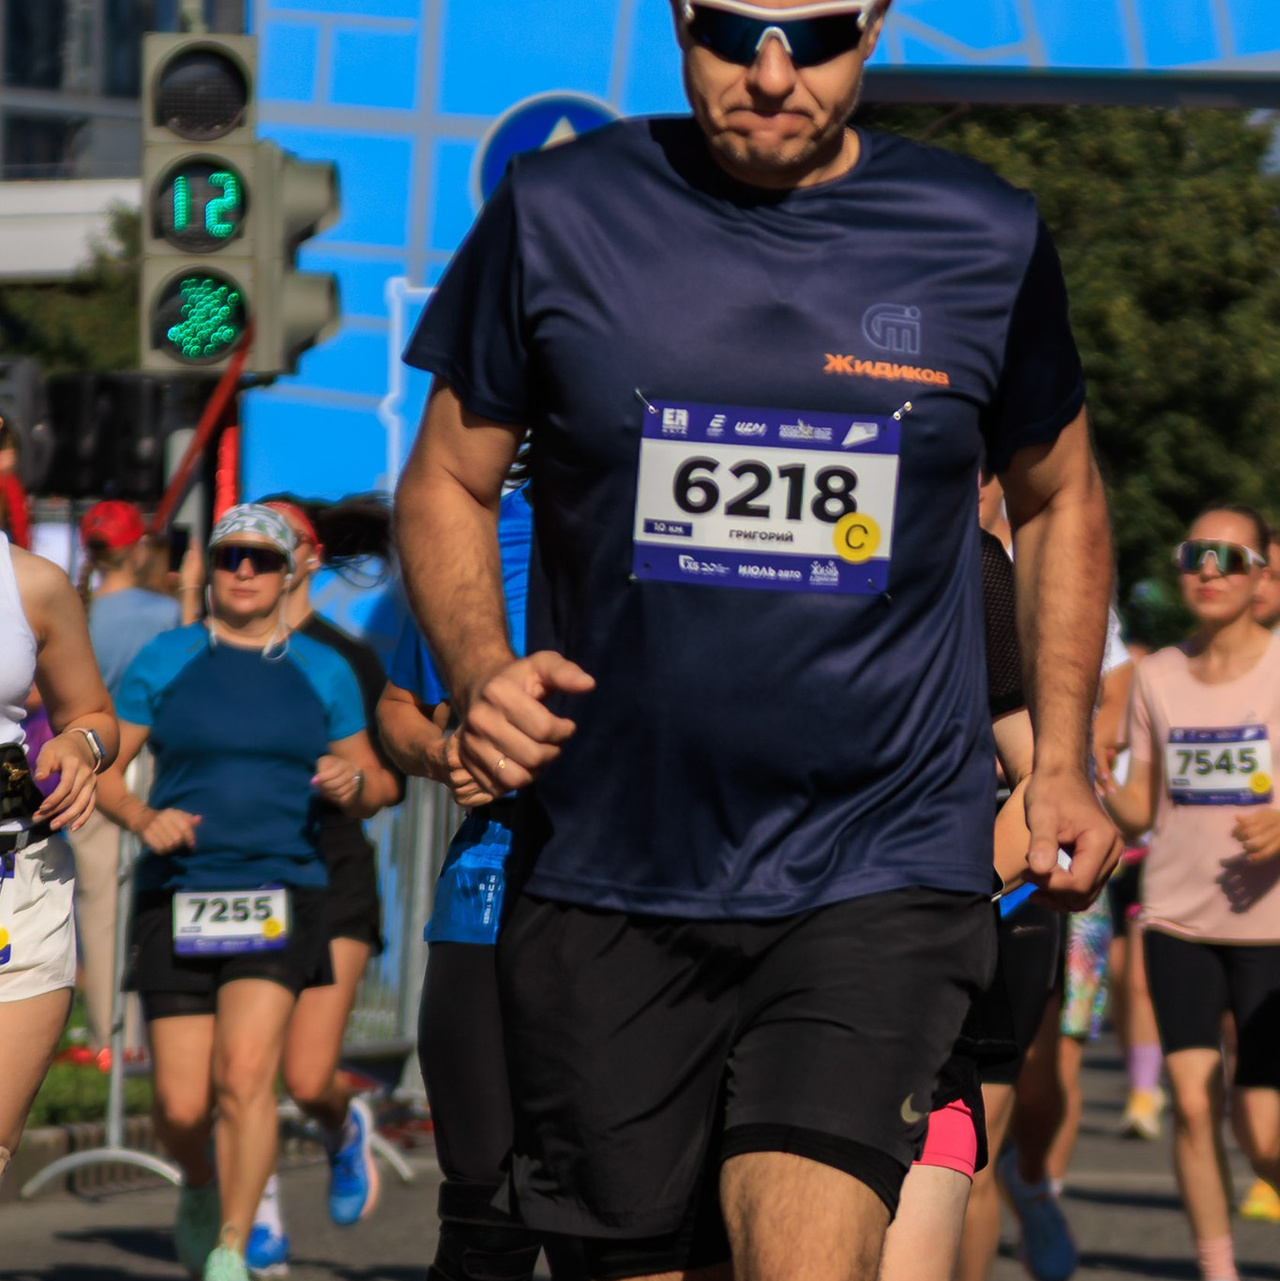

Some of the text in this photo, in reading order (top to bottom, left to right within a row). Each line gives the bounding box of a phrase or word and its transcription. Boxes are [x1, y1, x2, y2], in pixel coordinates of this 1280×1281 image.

[172, 170, 242, 239] 12
[672, 455, 858, 524] 6218
[728, 529, 794, 542] ГРИГОРИЙ
[1176, 747, 1259, 775] 7545
[188, 896, 273, 922] 7255
